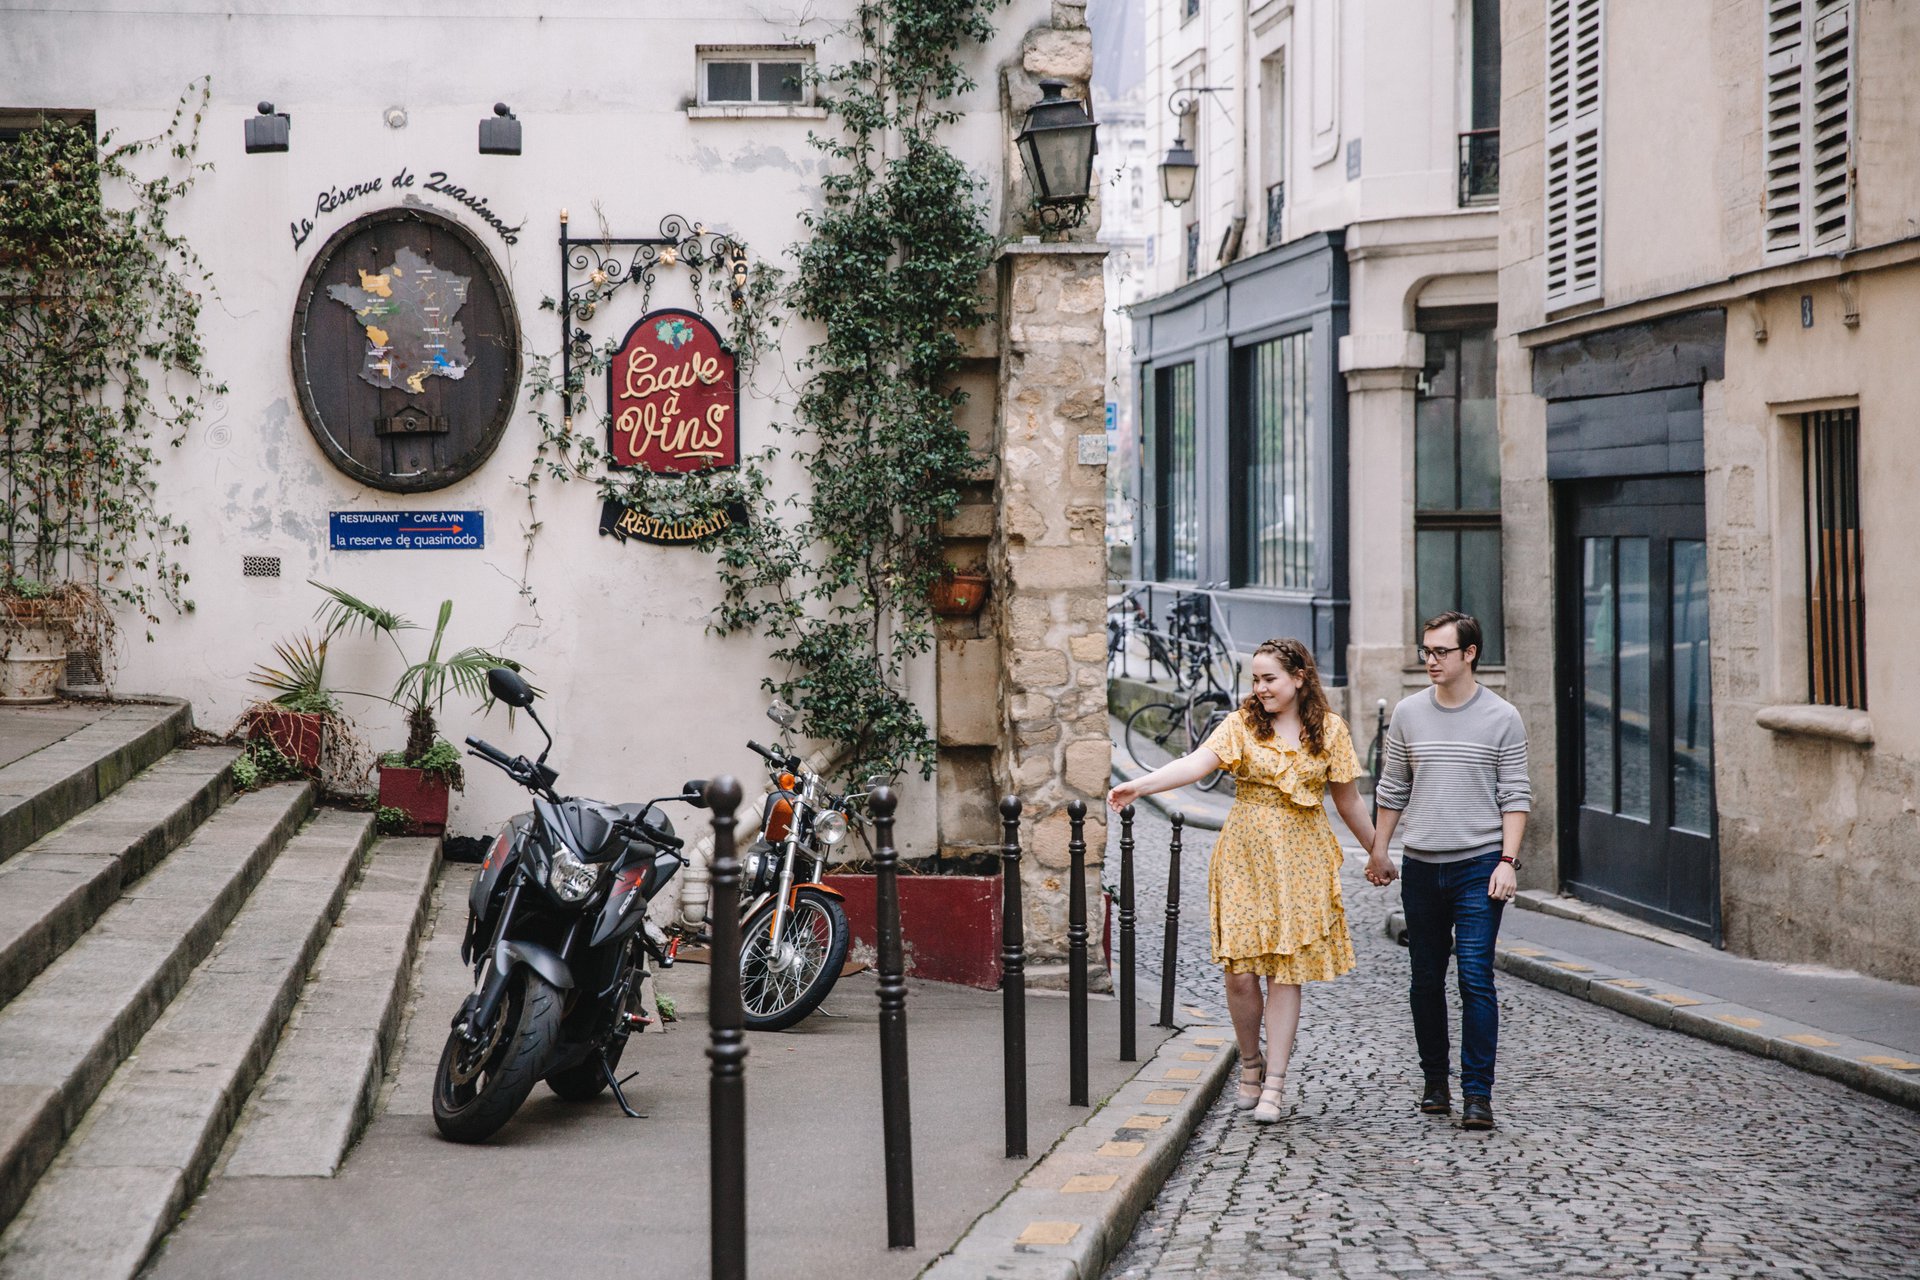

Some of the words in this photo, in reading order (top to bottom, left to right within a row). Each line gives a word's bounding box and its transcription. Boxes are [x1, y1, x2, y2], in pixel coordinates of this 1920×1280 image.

[291, 218, 314, 251] La
[315, 177, 383, 219] Réserve
[391, 166, 415, 188] de
[423, 171, 519, 246] Quasimodo
[1803, 298, 1811, 326] 3
[620, 346, 725, 400] Cave
[663, 390, 681, 417] à
[616, 402, 731, 458] Vins
[339, 514, 400, 523] RESTAURANT
[413, 514, 438, 523] CAVE
[439, 512, 449, 523] À
[448, 514, 464, 523] VIN
[336, 534, 346, 546] la
[349, 536, 393, 546] reserve
[396, 534, 411, 546] de
[414, 533, 478, 548] quasimodo
